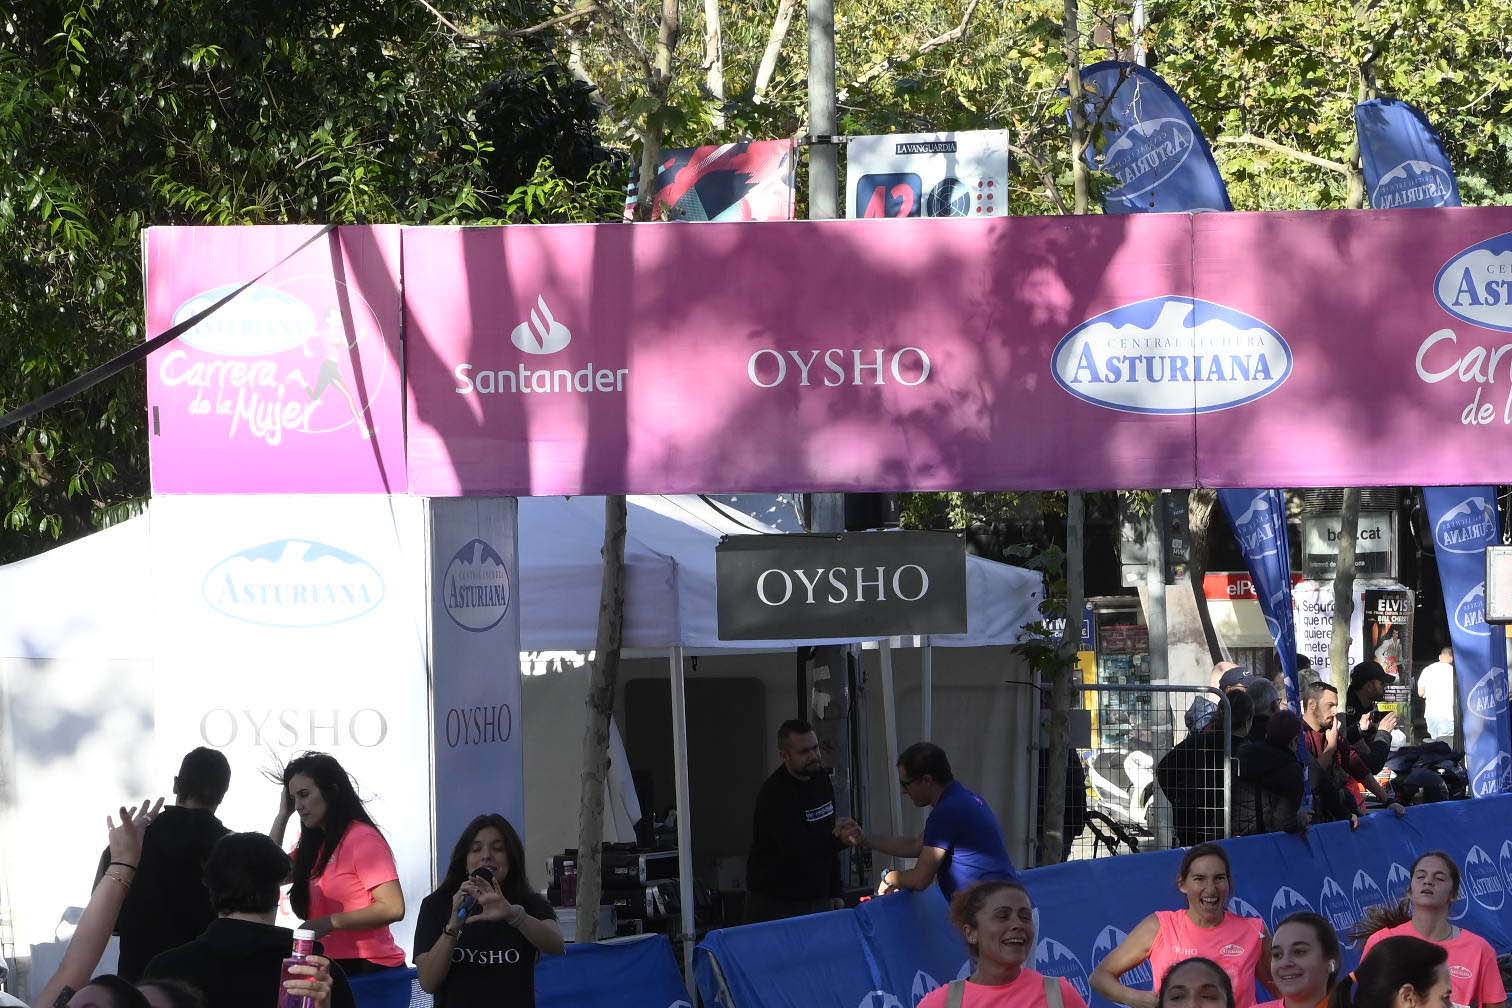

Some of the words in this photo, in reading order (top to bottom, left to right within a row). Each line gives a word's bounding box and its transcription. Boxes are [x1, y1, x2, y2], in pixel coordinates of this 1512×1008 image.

[908, 141, 957, 153] VANGUARDIA
[1107, 336, 1183, 349] CENTRAL
[160, 351, 279, 388] Carrera
[454, 362, 629, 395] Santander
[746, 346, 932, 389] OYSHO
[1070, 341, 1275, 385] ASTURIANA
[227, 384, 325, 446] Mujer
[1461, 387, 1496, 425] de
[216, 573, 371, 607] ASTURIANA
[448, 576, 507, 610] ASTURIANA
[756, 563, 930, 607] OYSHO
[1303, 616, 1320, 629] que
[1378, 600, 1410, 612] ELVIS
[199, 708, 388, 748] OYSHO
[445, 703, 513, 749] OYSHO
[450, 947, 520, 965] OYSHO
